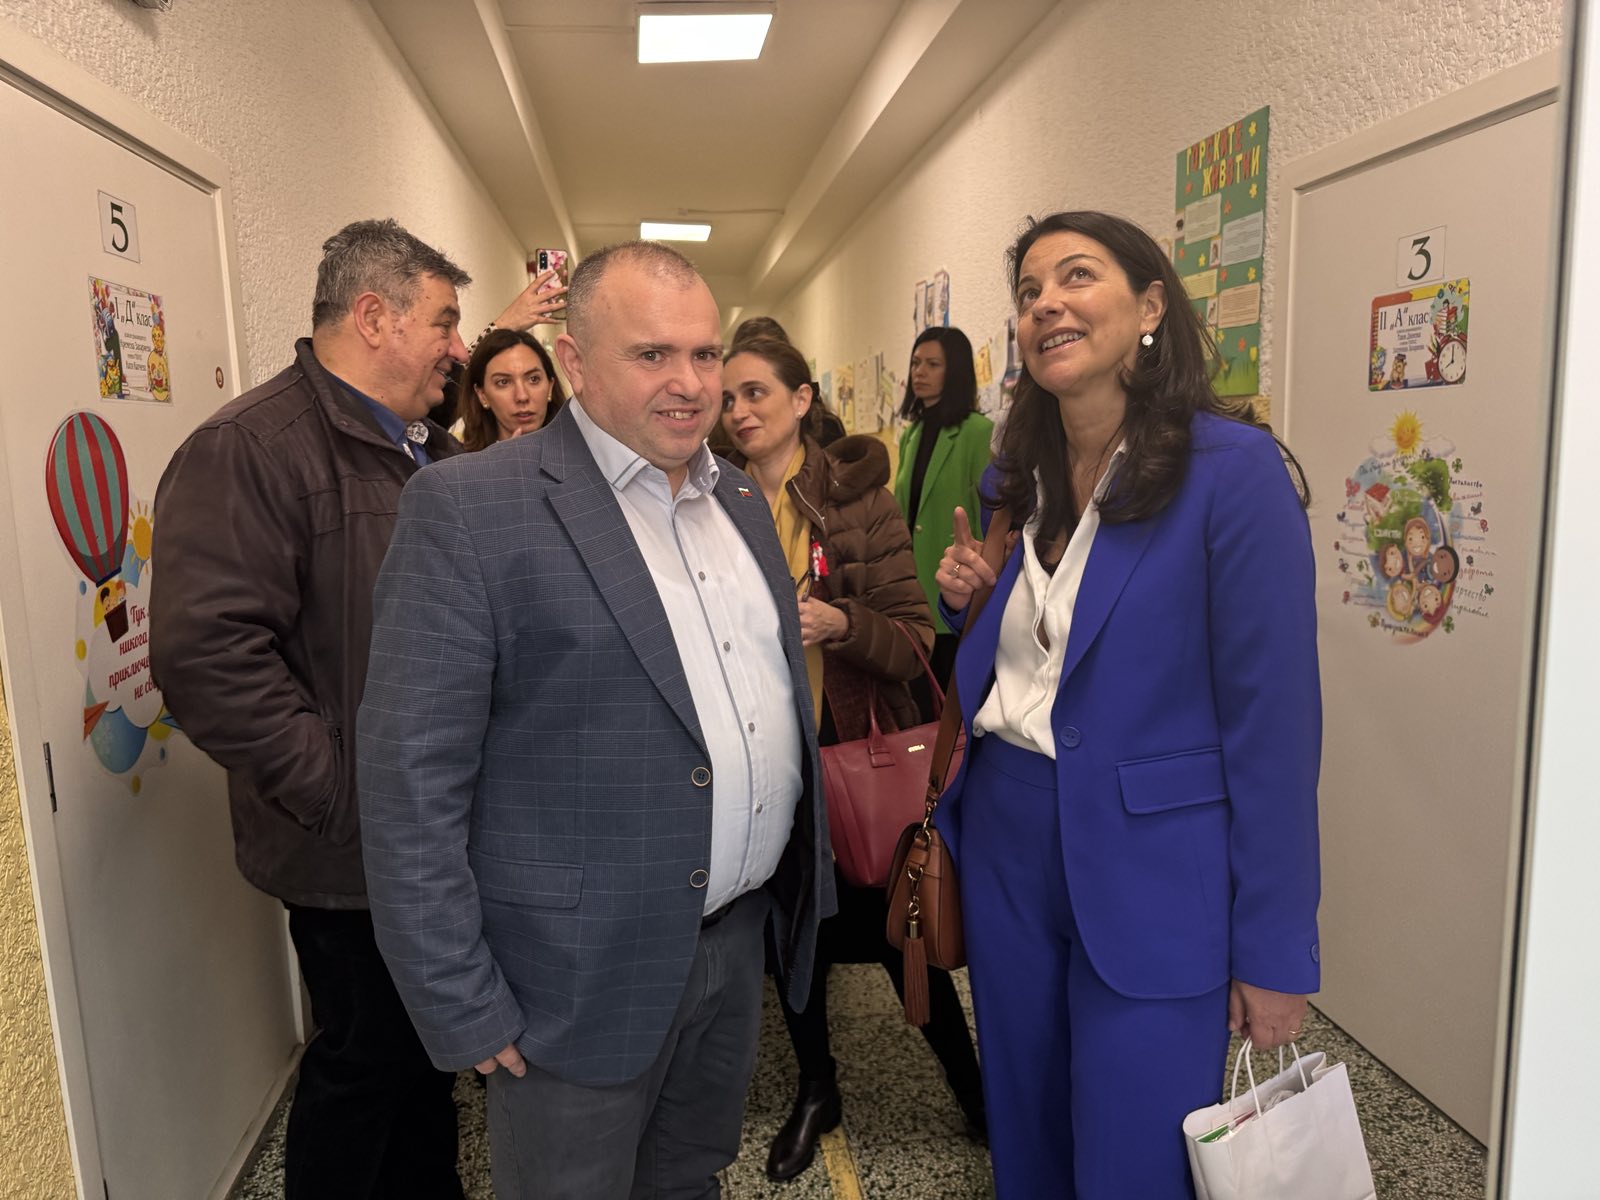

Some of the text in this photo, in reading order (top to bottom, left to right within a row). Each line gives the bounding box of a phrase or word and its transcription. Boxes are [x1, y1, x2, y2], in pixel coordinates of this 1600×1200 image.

[1186, 120, 1243, 176] ГОРСКИТЕ
[1202, 144, 1261, 197] ЖИВОТНИ
[110, 201, 129, 253] 5
[1407, 235, 1432, 281] 3
[136, 312, 153, 328] клас
[1408, 311, 1430, 327] клас
[130, 604, 147, 627] Тук
[119, 632, 149, 656] никога
[134, 684, 145, 701] не
